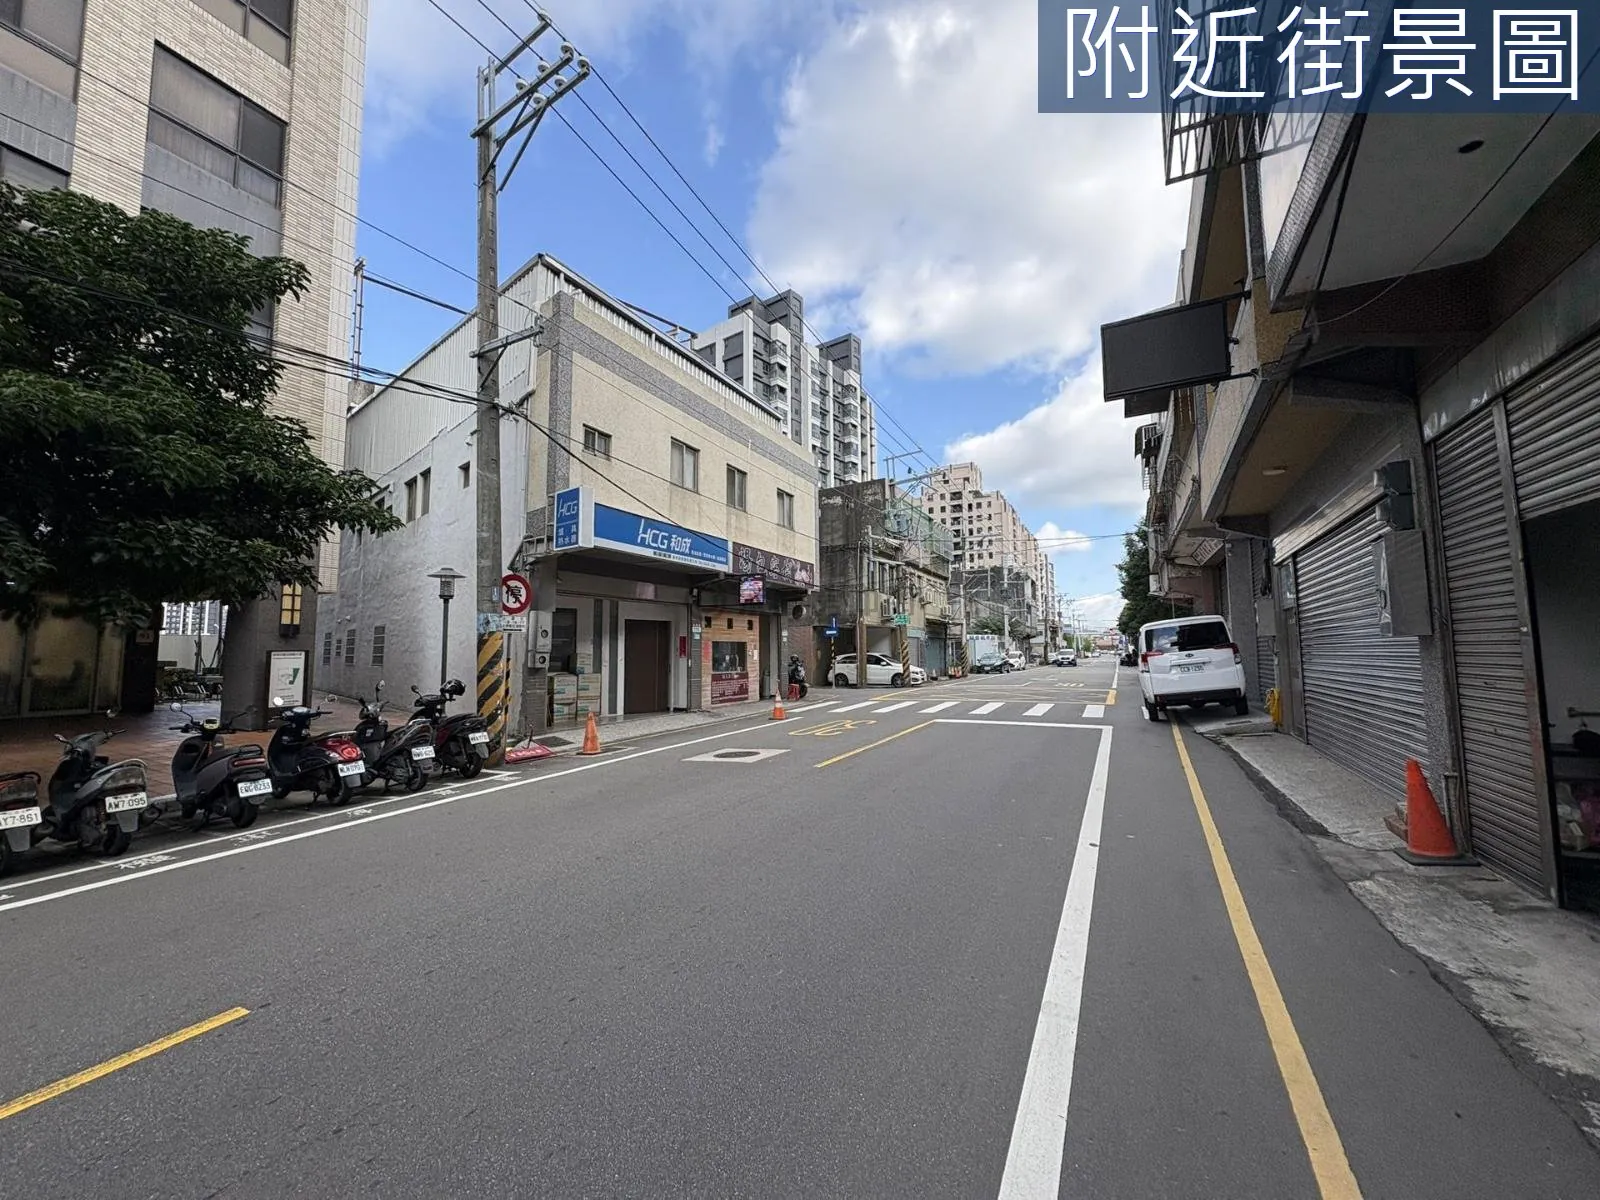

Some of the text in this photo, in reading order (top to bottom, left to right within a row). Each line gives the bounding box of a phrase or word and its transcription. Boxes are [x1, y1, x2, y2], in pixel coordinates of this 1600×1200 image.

[557, 498, 577, 518] HCG
[637, 519, 691, 555] HCG 和成
[505, 585, 523, 604] 停
